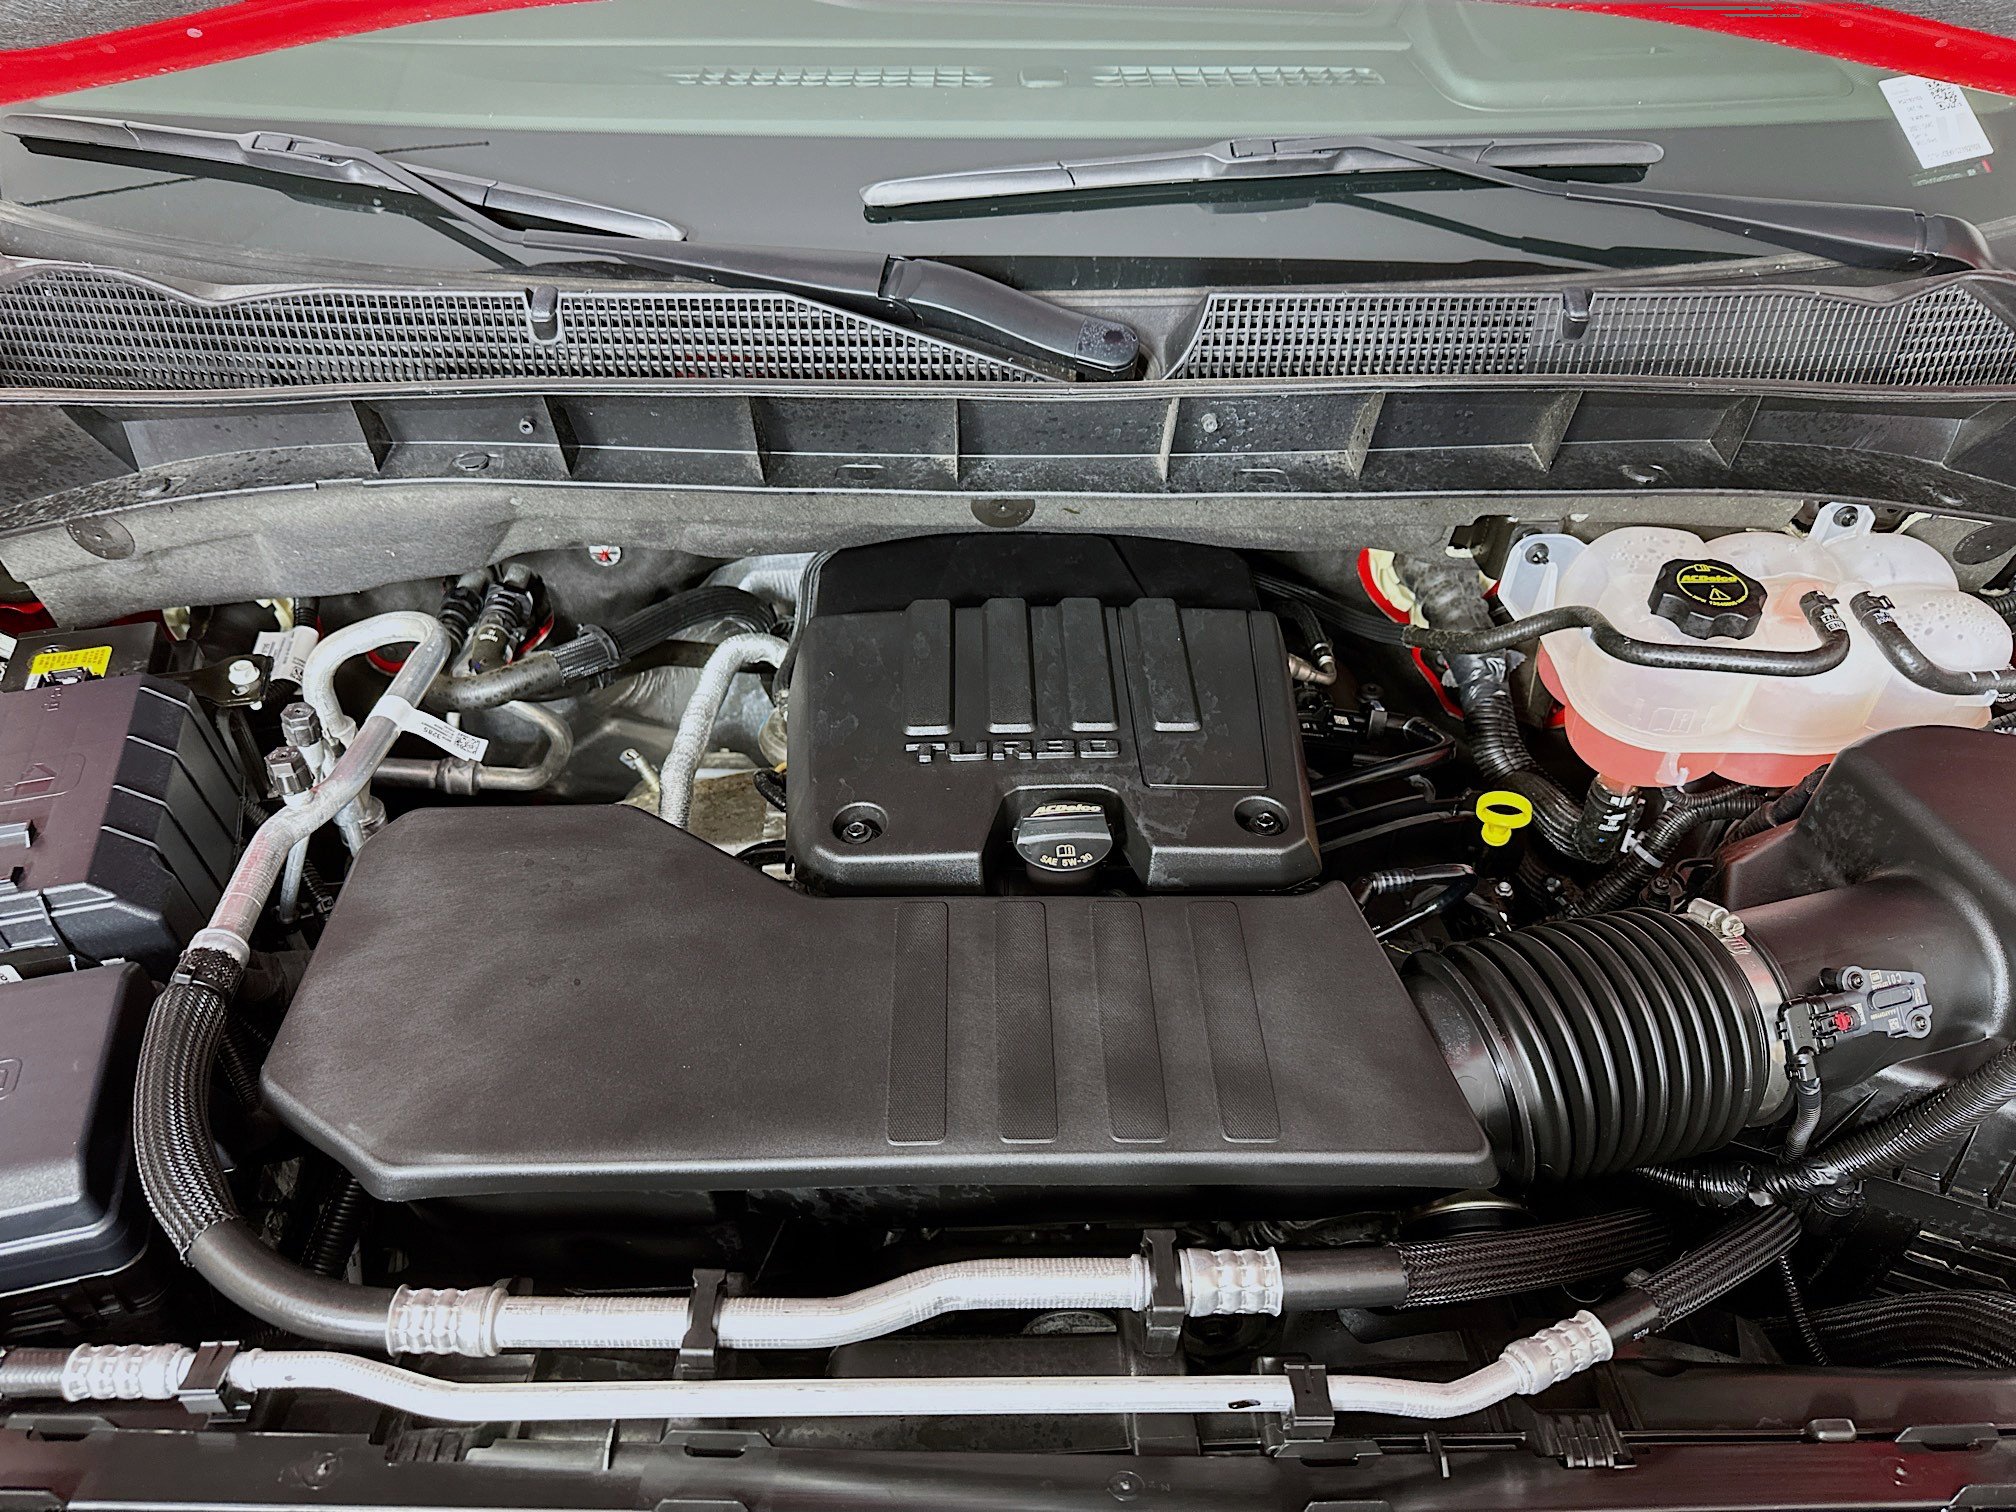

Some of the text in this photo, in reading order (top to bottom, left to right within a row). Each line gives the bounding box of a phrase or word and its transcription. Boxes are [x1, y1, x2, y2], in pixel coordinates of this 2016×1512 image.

[904, 738, 1120, 764] TURBO
[1031, 803, 1103, 816] ACDelco
[1039, 851, 1094, 867] SAE 5W-30
